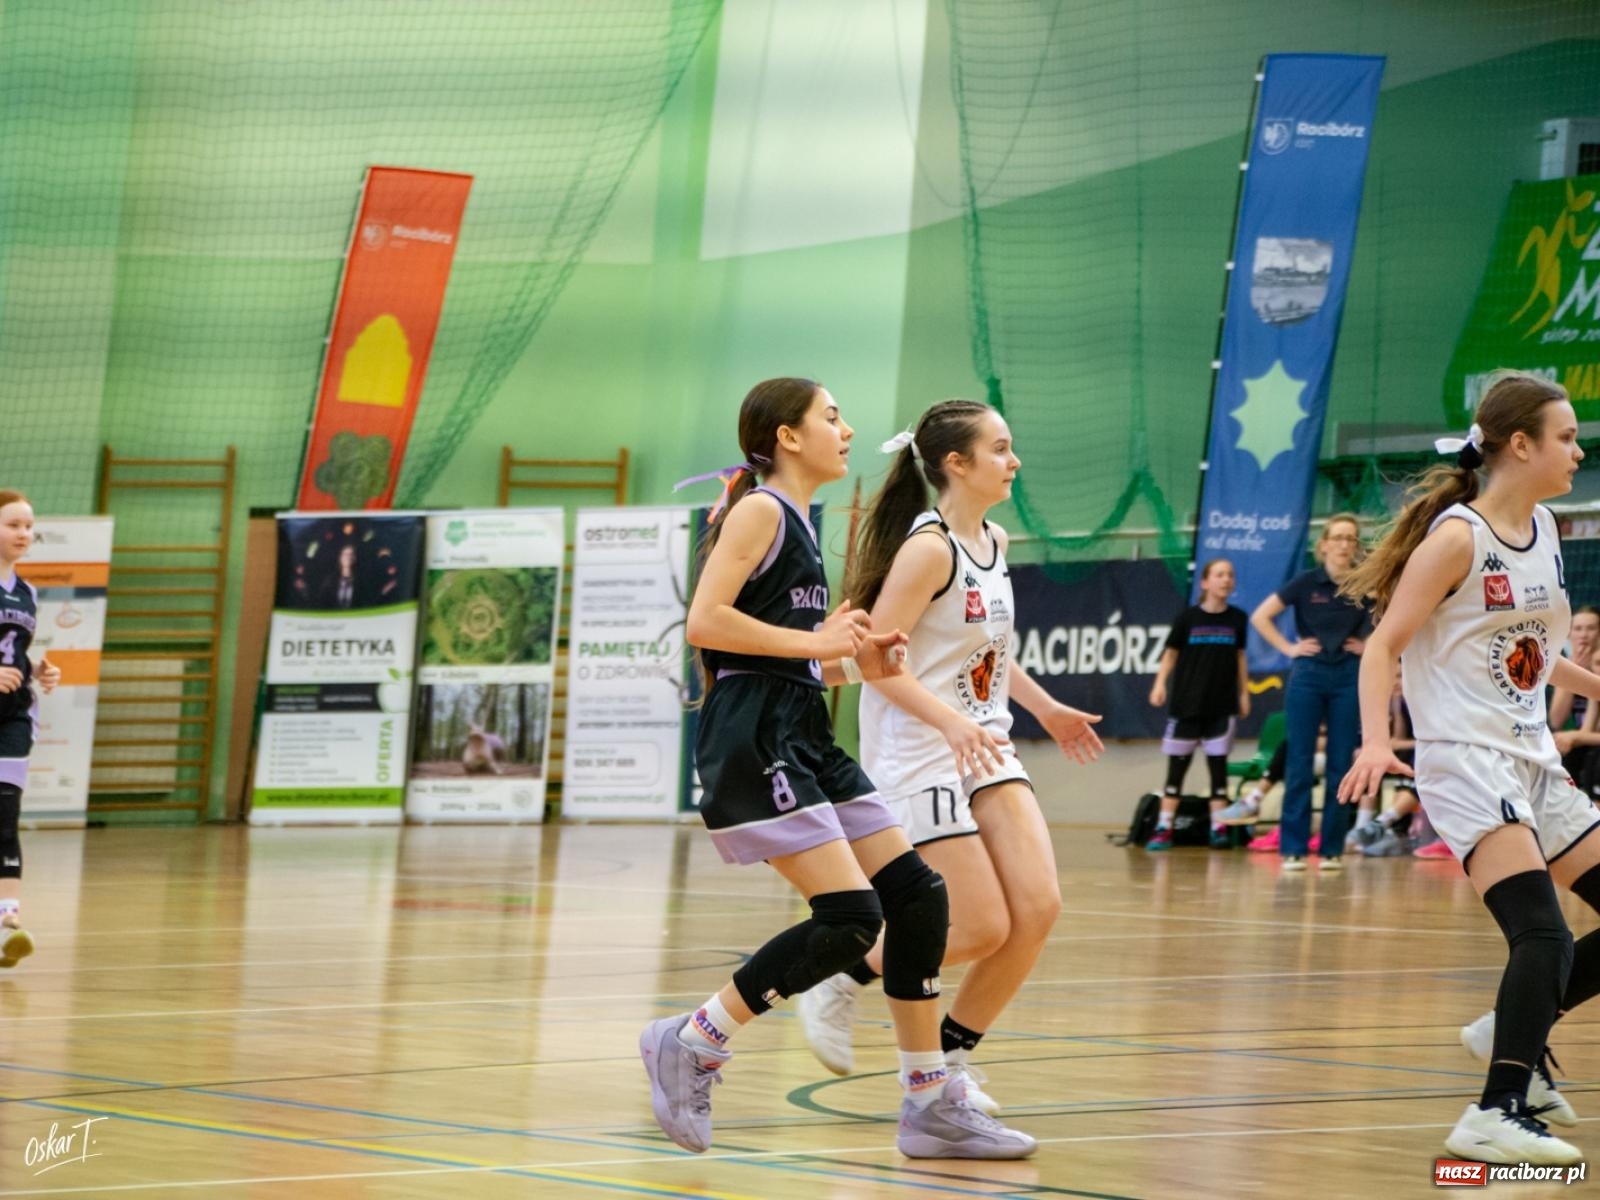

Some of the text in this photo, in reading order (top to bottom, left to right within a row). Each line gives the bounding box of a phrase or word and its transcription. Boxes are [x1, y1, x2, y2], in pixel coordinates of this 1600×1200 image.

[281, 638, 397, 658] DIETETYKA
[376, 719, 394, 783] OFERTA
[771, 769, 797, 812] 8
